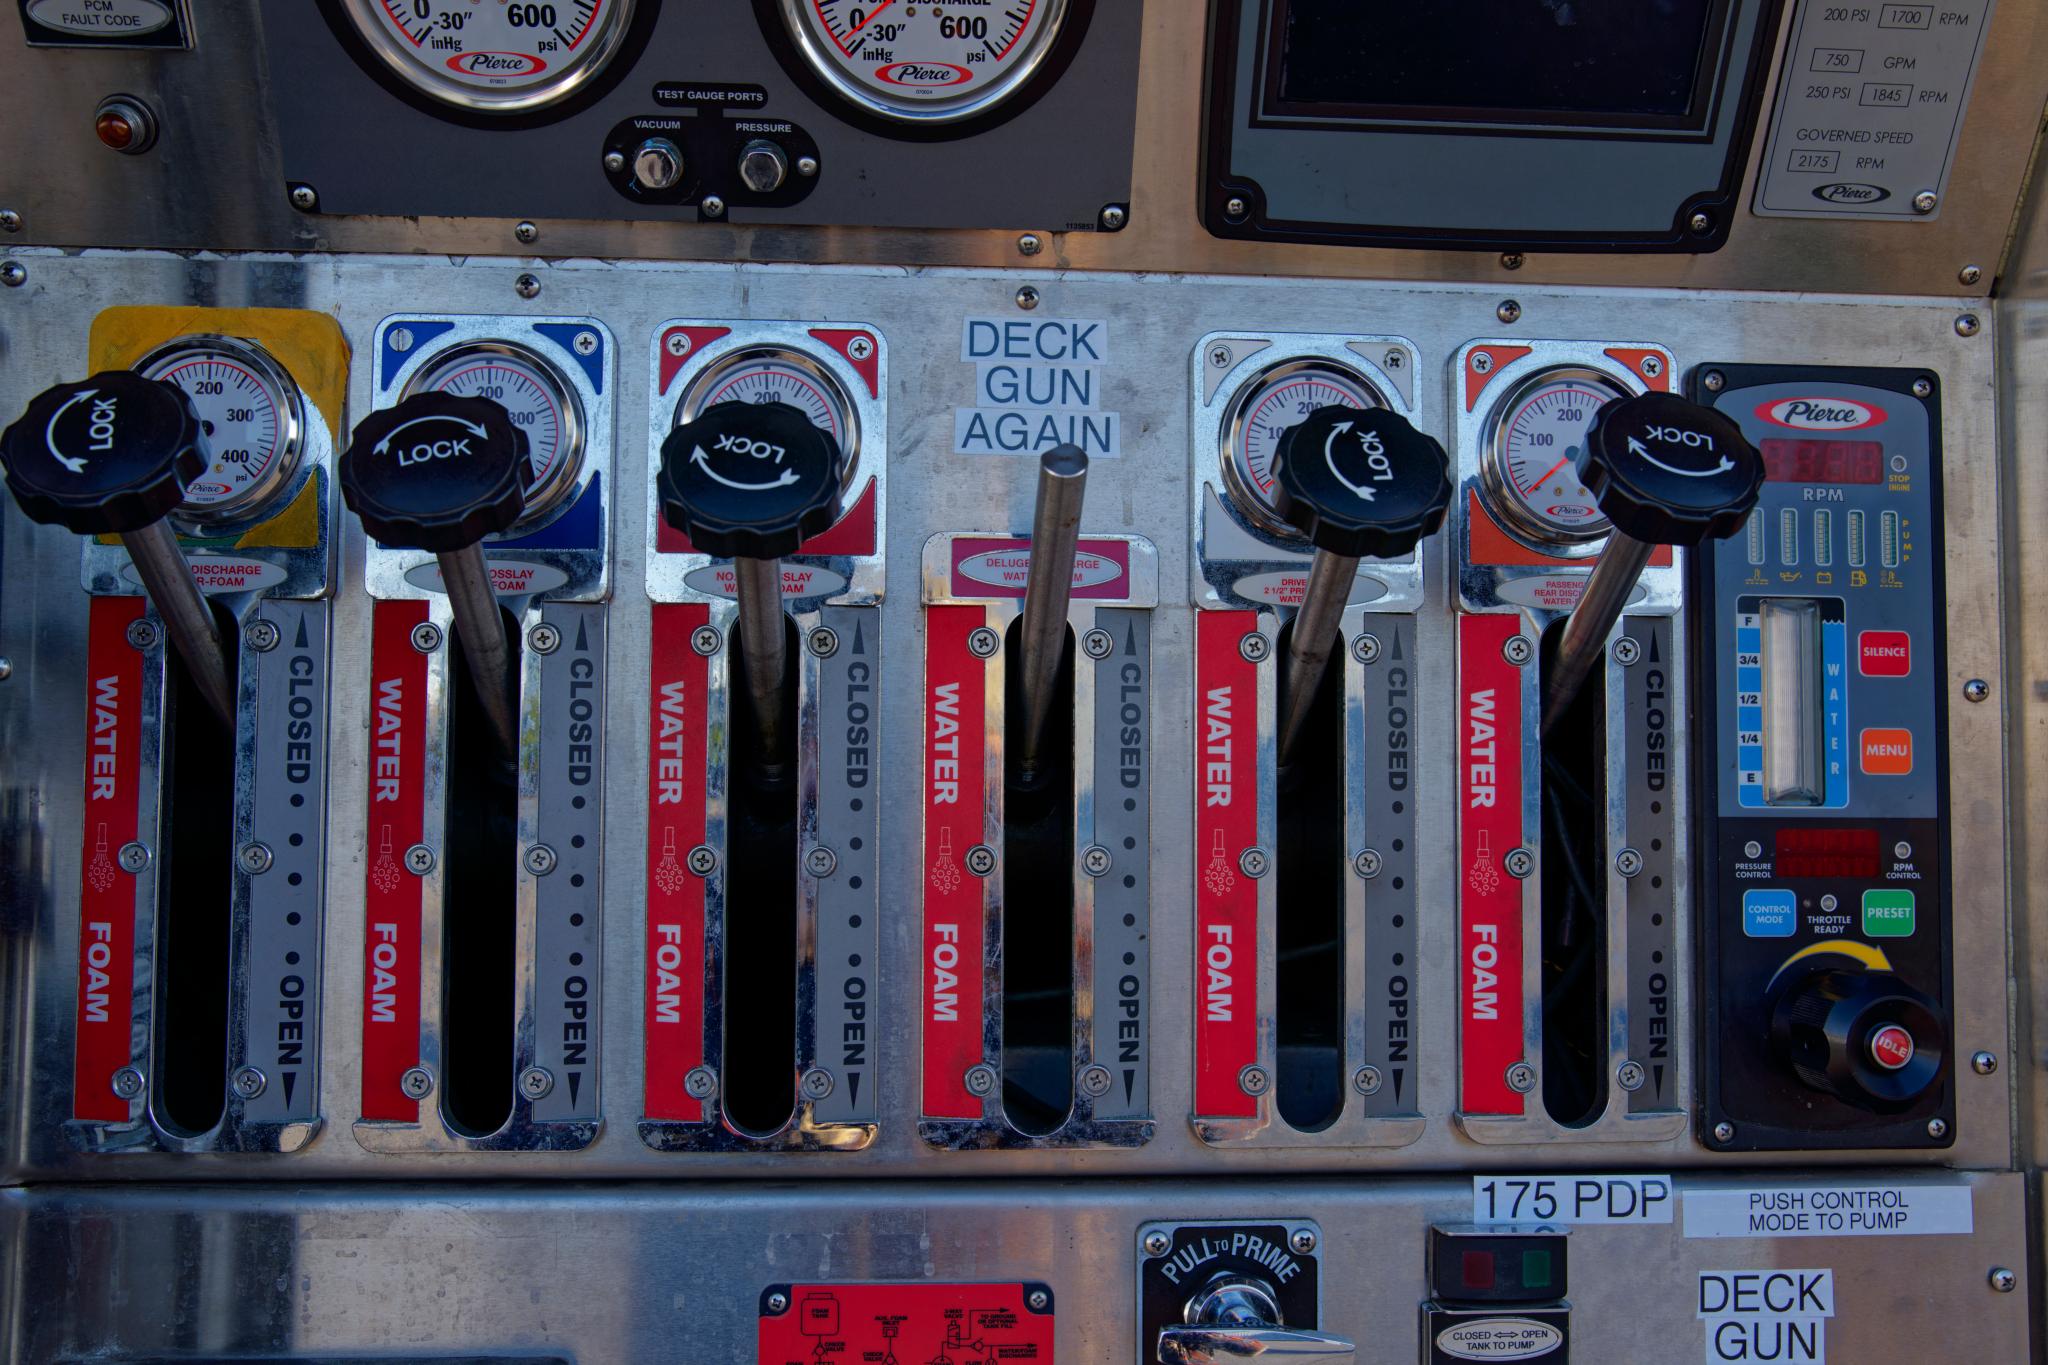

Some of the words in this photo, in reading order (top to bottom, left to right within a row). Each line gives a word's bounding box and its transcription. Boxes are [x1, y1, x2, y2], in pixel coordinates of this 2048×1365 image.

[84, 0, 113, 10] PCM
[414, 0, 430, 19] 0
[62, 14, 101, 25] FAULT
[104, 15, 141, 26] CODE
[507, 4, 556, 28] 600
[850, 8, 865, 31] 0
[1823, 8, 1848, 21] 200
[1850, 8, 1870, 22] PSI
[1891, 10, 1921, 24] 1700
[1939, 12, 1969, 26] RPM
[940, 16, 987, 39] 600
[431, 36, 463, 52] inHg
[538, 38, 557, 54] psi
[470, 54, 524, 71] Pierce
[863, 48, 893, 63] inHg
[966, 49, 985, 64] psi
[1826, 54, 1850, 66] 750
[1883, 56, 1916, 70] GPM
[897, 65, 950, 82] Pierce
[657, 90, 684, 100] TEST
[688, 91, 725, 101] GAUGE
[728, 92, 764, 102] PORTS
[1806, 86, 1830, 99] 250
[1832, 86, 1852, 100] PSI
[1872, 88, 1902, 102] 1845
[1919, 90, 1948, 103] RPM
[634, 120, 681, 130] VACUUM
[736, 122, 792, 133] PRESSURE
[1796, 128, 1871, 143] GOVERNED
[1874, 131, 1914, 145] SPEED
[1798, 154, 1830, 168] 2175
[1856, 157, 1884, 170] RPM
[1828, 185, 1872, 200] Pierce
[968, 321, 1100, 360] DECK
[195, 382, 224, 395] 200
[476, 386, 504, 399] 200
[985, 366, 1091, 406] GUN
[754, 392, 780, 405] 200
[226, 408, 254, 422] 300
[510, 412, 535, 425] 300
[1558, 408, 1582, 422] 200
[1784, 400, 1856, 424] Pierce
[89, 397, 118, 451] LOCK
[961, 412, 1112, 453] AGAIN
[1528, 434, 1554, 446] 100
[1645, 424, 1714, 452] LOCK
[221, 450, 249, 464] 400
[398, 438, 473, 468] LOCK
[712, 433, 786, 464] LOCK
[1356, 430, 1394, 481] LOCK
[236, 474, 248, 483] psi
[1888, 474, 1910, 484] STOP
[190, 484, 220, 494] Pierce
[1803, 488, 1844, 502] RPM
[1888, 484, 1910, 492] ENGINE
[1557, 504, 1584, 517] Pierce
[1902, 520, 1912, 562] PUMP
[192, 565, 262, 576] DISCHARGE
[986, 558, 1031, 568] DELUGE
[1534, 590, 1558, 598] REAR
[1745, 616, 1752, 626] F
[1864, 646, 1906, 657] SILENCE
[1740, 656, 1758, 665] 3/4
[1740, 695, 1758, 704] 1/2
[286, 654, 314, 784] CLOSED
[568, 658, 592, 787] CLOSED
[846, 661, 870, 789] CLOSED
[1120, 662, 1142, 789] CLOSED
[1827, 664, 1840, 774] WATER
[93, 675, 119, 801] WATER
[1386, 667, 1408, 793] CLOSED
[1646, 670, 1666, 792] CLOSED
[1740, 734, 1758, 743] 1/4
[376, 678, 403, 802] WATER
[658, 681, 684, 806] WATER
[933, 682, 960, 806] WATER
[1206, 686, 1233, 808] WATER
[1470, 688, 1496, 809] WATER
[1866, 744, 1908, 756] MENU
[1747, 773, 1754, 782] E
[1735, 862, 1772, 871] PRESSURE
[1735, 871, 1772, 879] CONTROL
[1894, 863, 1914, 872] RPM
[1886, 872, 1922, 880] CONTROL
[1748, 904, 1792, 914] CONTROL
[1867, 908, 1911, 919] PRESET
[1756, 916, 1784, 924] MODE
[1807, 916, 1852, 925] THROTTLE
[1814, 925, 1846, 934] READY
[86, 920, 112, 1023] FOAM
[372, 922, 398, 1023] FOAM
[656, 924, 682, 1024] FOAM
[932, 923, 958, 1022] FOAM
[1206, 925, 1233, 1023] FOAM
[1472, 924, 1498, 1021] FOAM
[278, 975, 305, 1066] OPEN
[564, 976, 588, 1066] OPEN
[843, 976, 866, 1066] OPEN
[1118, 975, 1140, 1063] OPEN
[1388, 975, 1409, 1062] OPEN
[1648, 972, 1668, 1058] OPEN
[1878, 1035, 1909, 1060] IDLE
[1482, 1180, 1557, 1219] 175
[1575, 1180, 1668, 1218] PDP
[1750, 1192, 1804, 1210] PUSH
[1810, 1190, 1909, 1208] CONTROL
[1749, 1214, 1809, 1231] MODE
[1815, 1213, 1844, 1230] TO
[1850, 1212, 1908, 1230] PUMP
[1160, 1238, 1219, 1285] PULL
[1214, 1240, 1228, 1252] TO
[1231, 1233, 1301, 1284] PRIME
[1700, 1274, 1826, 1313] DECK
[1453, 1331, 1492, 1340] CLOSED
[1522, 1330, 1548, 1339] OPEN
[1714, 1321, 1816, 1360] GUN
[1466, 1342, 1490, 1350] TANK
[1493, 1342, 1504, 1350] TO
[1508, 1341, 1535, 1350] PUMP
